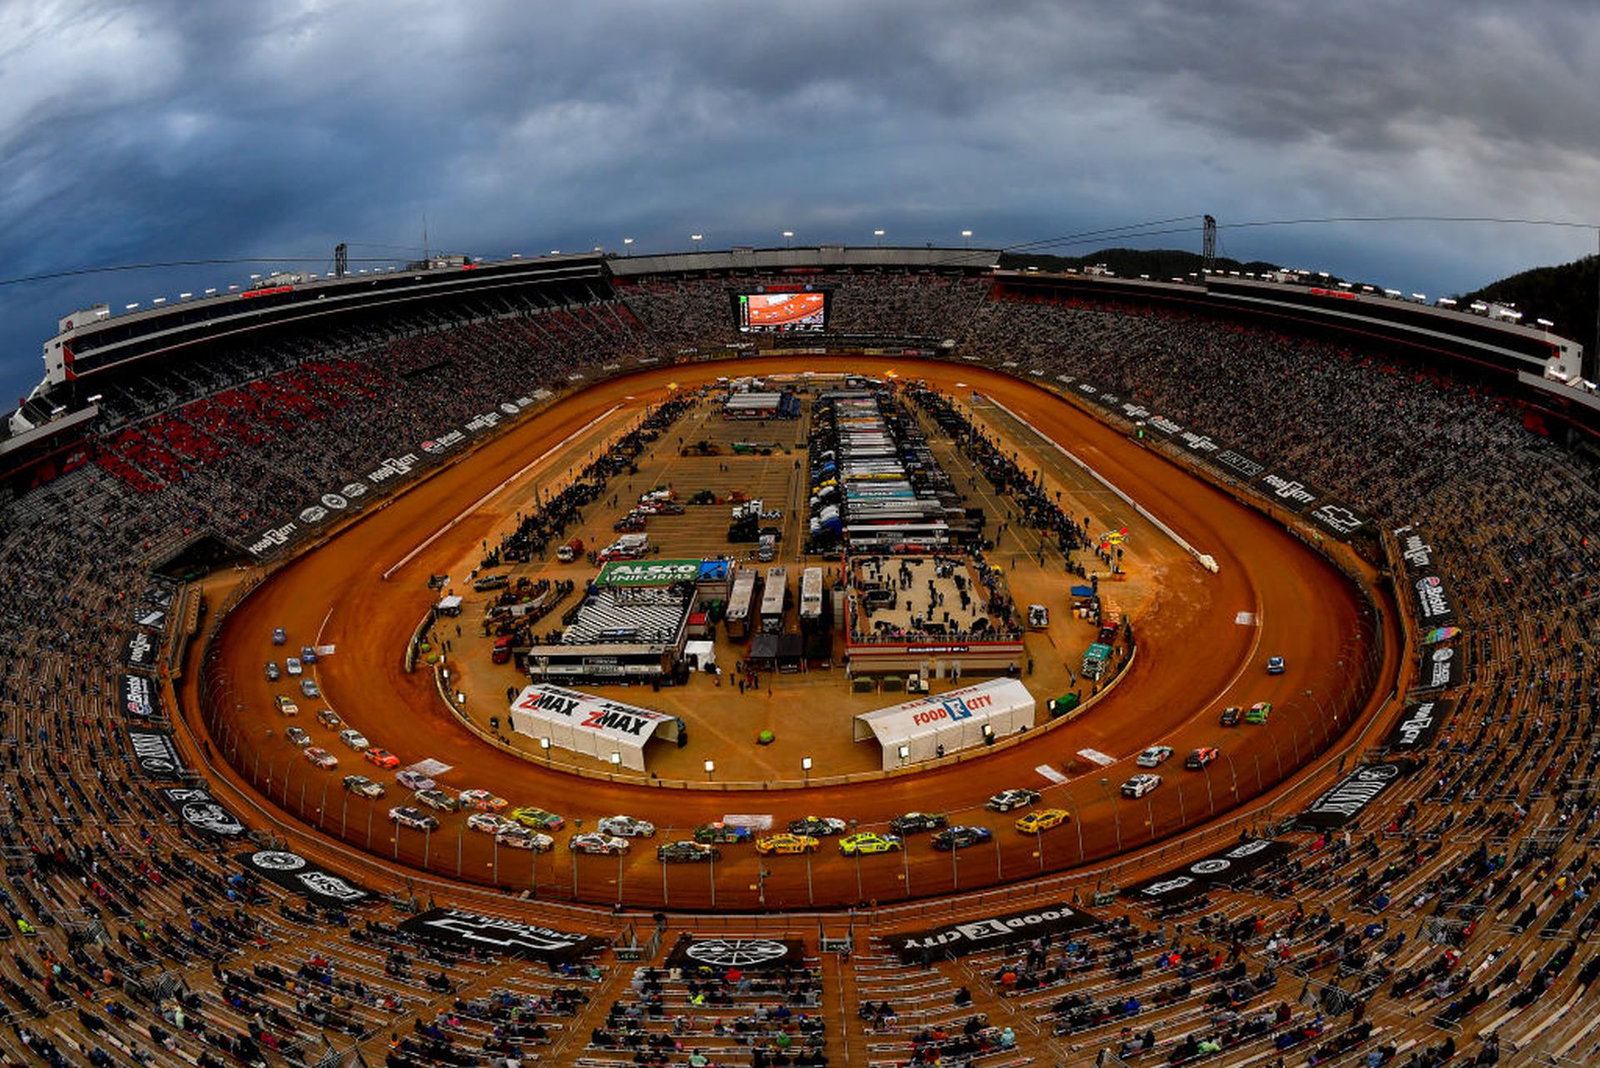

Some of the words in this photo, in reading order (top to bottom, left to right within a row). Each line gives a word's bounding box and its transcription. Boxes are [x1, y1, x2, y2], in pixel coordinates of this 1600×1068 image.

[912, 707, 948, 726] FOOD
[966, 694, 993, 711] CITY
[1005, 907, 1075, 928] FOOD
[904, 931, 962, 950] CITY
